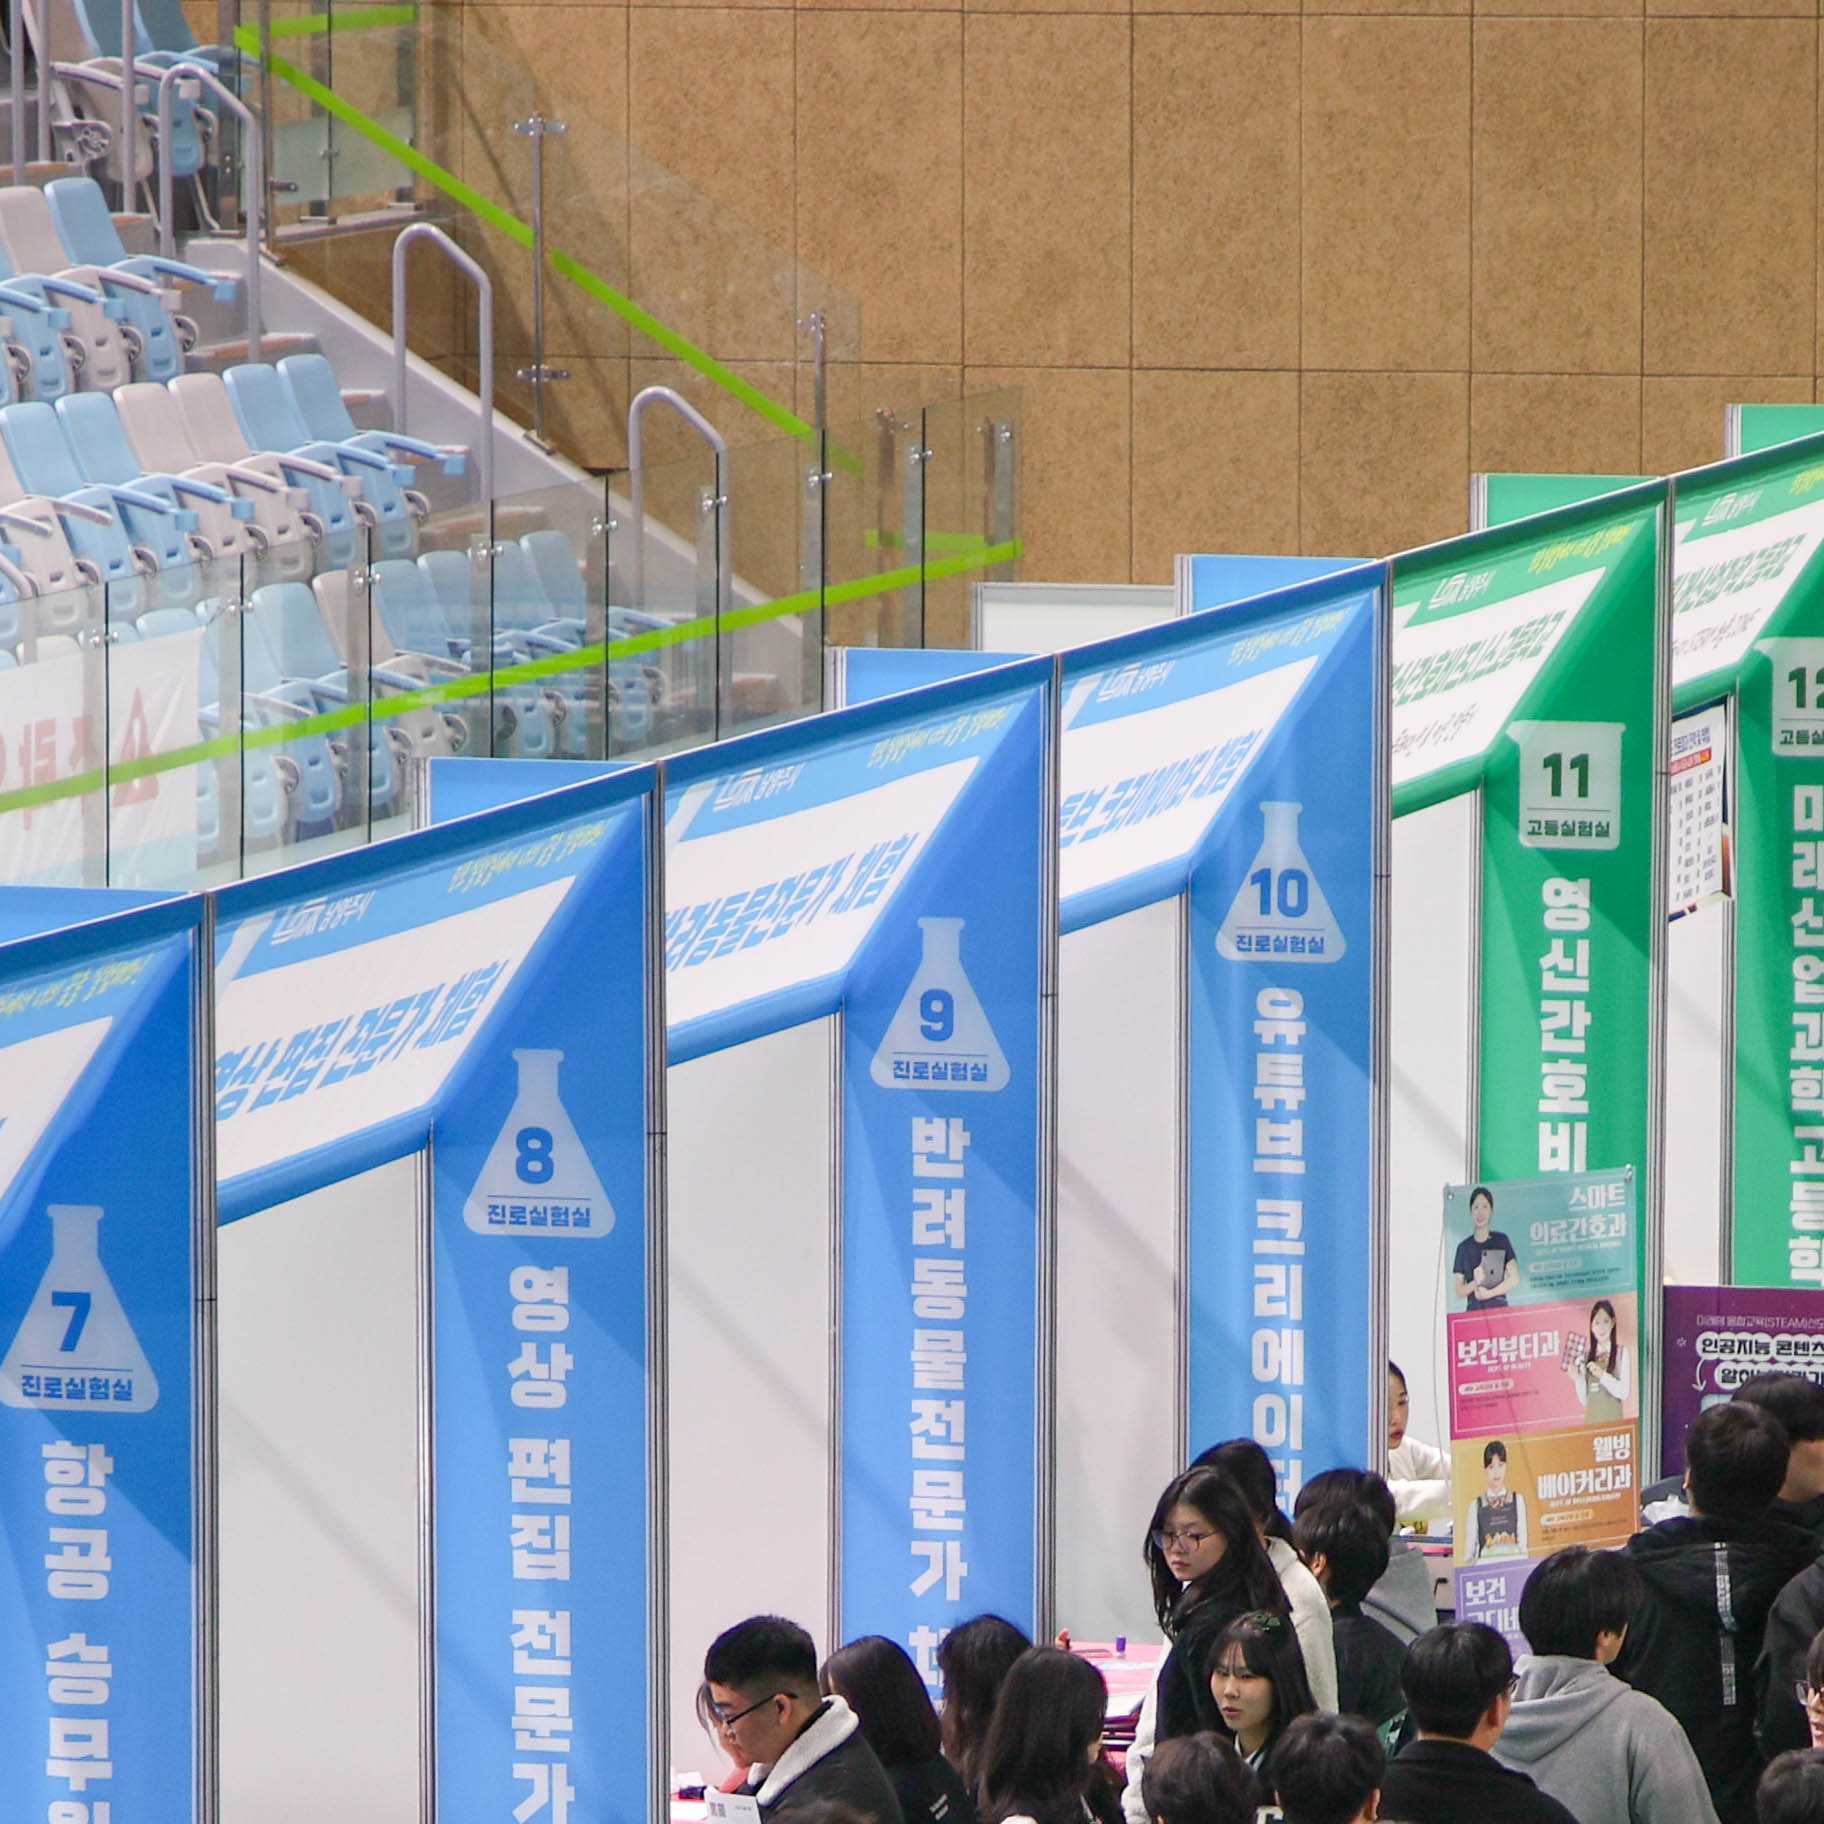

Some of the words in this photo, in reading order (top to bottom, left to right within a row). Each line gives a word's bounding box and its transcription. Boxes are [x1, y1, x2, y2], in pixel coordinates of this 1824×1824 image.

[1543, 753, 1589, 798] 11
[1528, 820, 1610, 838] 고등실험실
[828, 833, 919, 913] 체험
[1251, 868, 1309, 917] 10
[1235, 934, 1324, 954] 진로실험실
[247, 1015, 353, 1114] 편집
[318, 982, 446, 1089] 전문가
[413, 959, 509, 1050] 체험
[920, 988, 954, 1042] 9
[893, 1060, 987, 1082] 진로실험실
[1253, 987, 1306, 1174] 유튜브
[515, 1127, 554, 1184] 8
[487, 1204, 591, 1228] 진로실험실
[1569, 1183, 1626, 1212] 스마트
[1530, 1213, 1627, 1246] 의료간호과
[51, 1291, 91, 1352] 7
[507, 1264, 574, 1409] 영상
[1252, 1198, 1305, 1480] 크리에이
[909, 1117, 970, 1601] 반려동물전문가
[1458, 1331, 1560, 1367] 보건뷰티과
[1702, 1338, 1770, 1354] 인공지능
[21, 1375, 134, 1401] 진로실험실
[1593, 1433, 1631, 1462] 웰빙
[1538, 1464, 1632, 1499] 베이커리과
[42, 1440, 114, 1601] 항공
[507, 1437, 572, 1581] 편집
[1466, 1577, 1506, 1606] 보건
